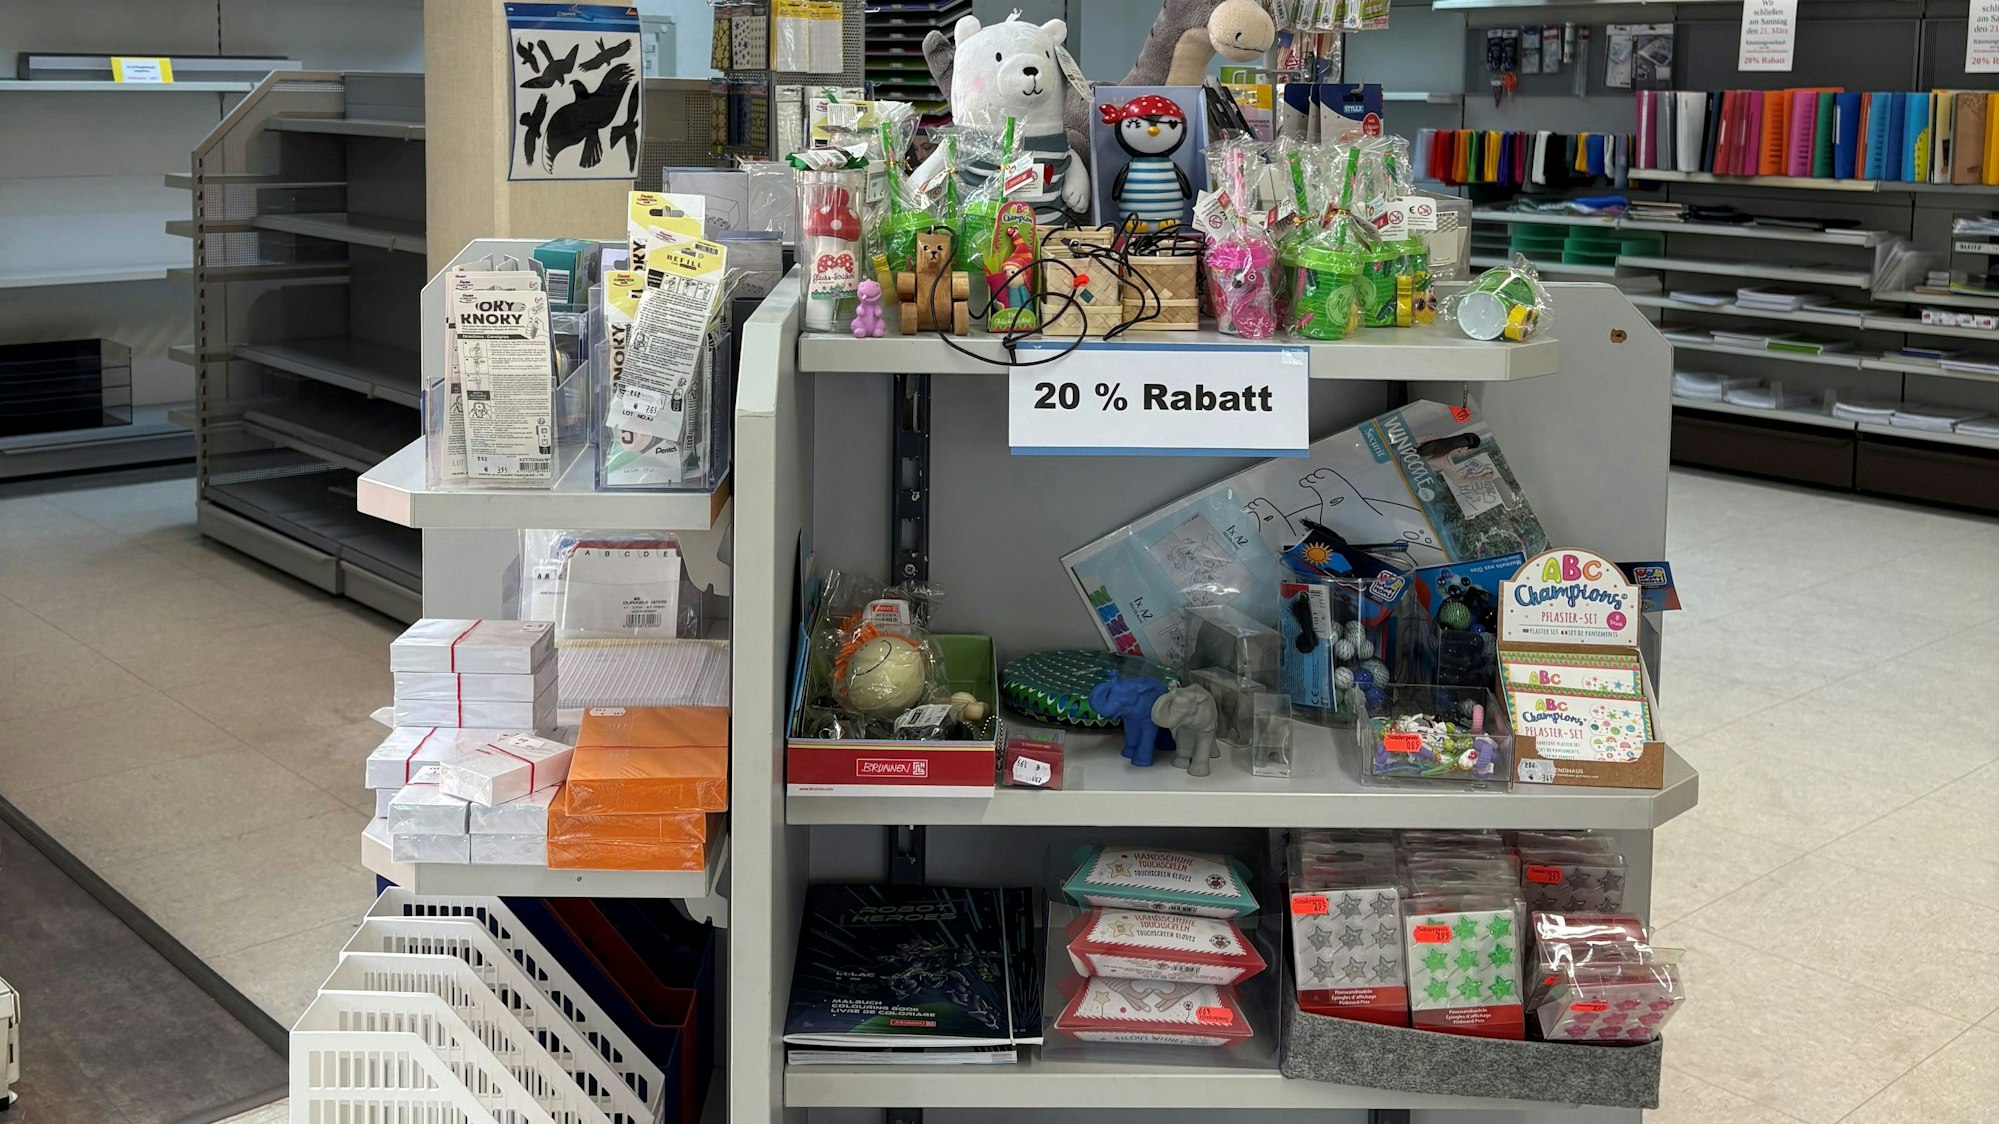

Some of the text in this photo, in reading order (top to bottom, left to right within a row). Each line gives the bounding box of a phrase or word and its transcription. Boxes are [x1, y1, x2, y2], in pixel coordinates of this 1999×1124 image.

[1761, 18, 1787, 26] Samstag
[667, 254, 702, 268] REFILL
[460, 314, 523, 325] KNOKY
[1034, 382, 1272, 412] 20 % Rabatt
[1366, 428, 1386, 457] Securit
[1542, 554, 1602, 584] ABC
[1541, 611, 1598, 625] PFLASTER-SET
[1529, 670, 1561, 685] ABC
[1535, 699, 1568, 711] ABC
[1525, 726, 1583, 739] PFLASTER-SET
[861, 763, 911, 773] BRUNNEN
[1134, 853, 1195, 866] HANDSCHUHE
[1138, 861, 1188, 871] TOUCHSCREEN
[1134, 870, 1192, 883] TOUCHSCREEN GLOVES
[859, 904, 951, 914] ROBOT
[851, 912, 957, 922] HEROES
[1140, 922, 1190, 932] TOUCHSCREEN
[1136, 930, 1196, 942] TOUCHSCREEN GLOVES
[831, 1003, 890, 1011] COLOURING
